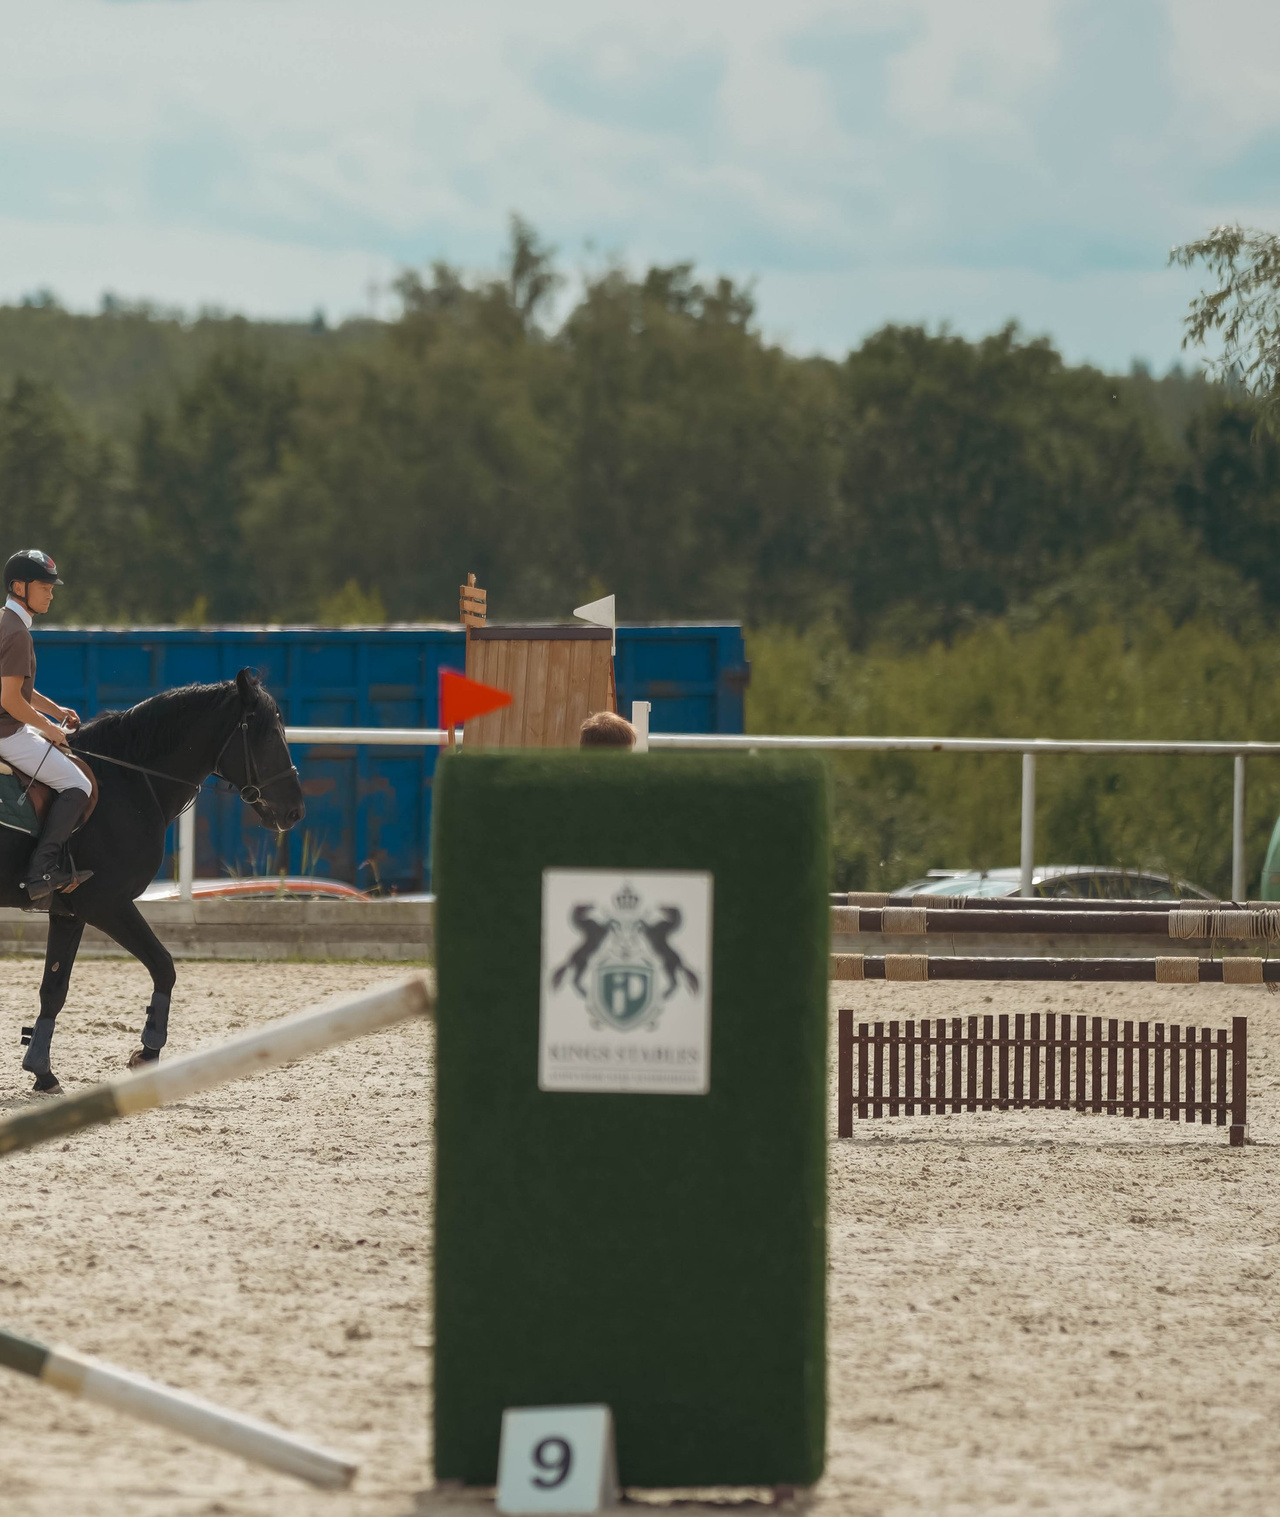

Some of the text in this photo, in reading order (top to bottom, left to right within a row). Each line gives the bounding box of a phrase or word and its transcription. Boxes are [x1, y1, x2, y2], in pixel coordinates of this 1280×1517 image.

[549, 1045, 698, 1063] KINGS STABLES
[531, 1435, 572, 1489] 9
